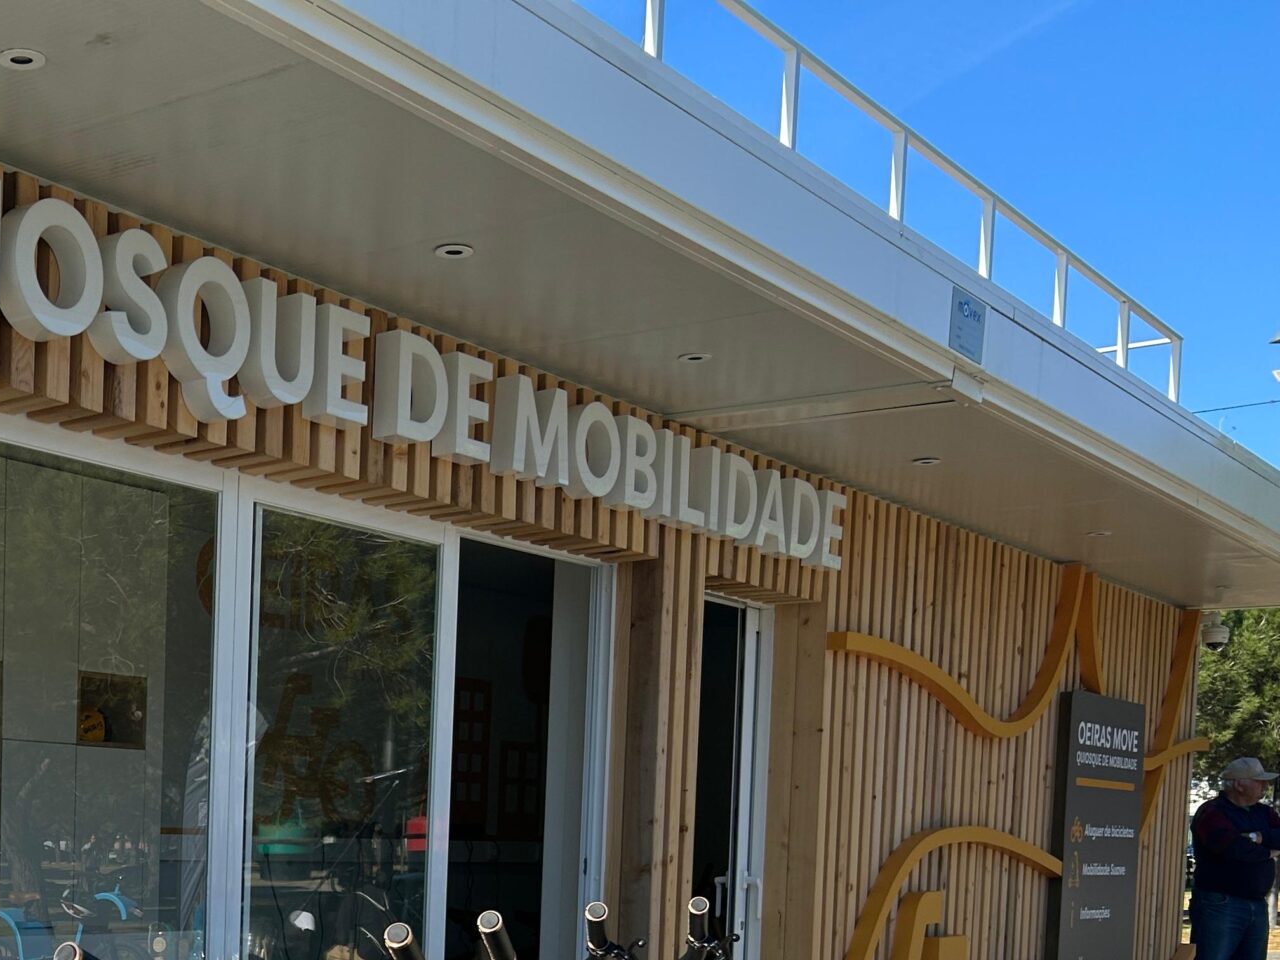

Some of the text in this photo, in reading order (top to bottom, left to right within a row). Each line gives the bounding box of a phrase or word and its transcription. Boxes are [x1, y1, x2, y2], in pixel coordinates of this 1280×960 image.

[372, 329, 493, 465] DE
[490, 372, 848, 571] MOBILIDADE
[1078, 721, 1138, 752] OEIRAS MOVE
[1077, 751, 1137, 771] QUIOSQUE DE MOBILIDADE
[1084, 824, 1135, 840] Aluguer de bicicletas
[1082, 863, 1110, 875] Mobilidade
